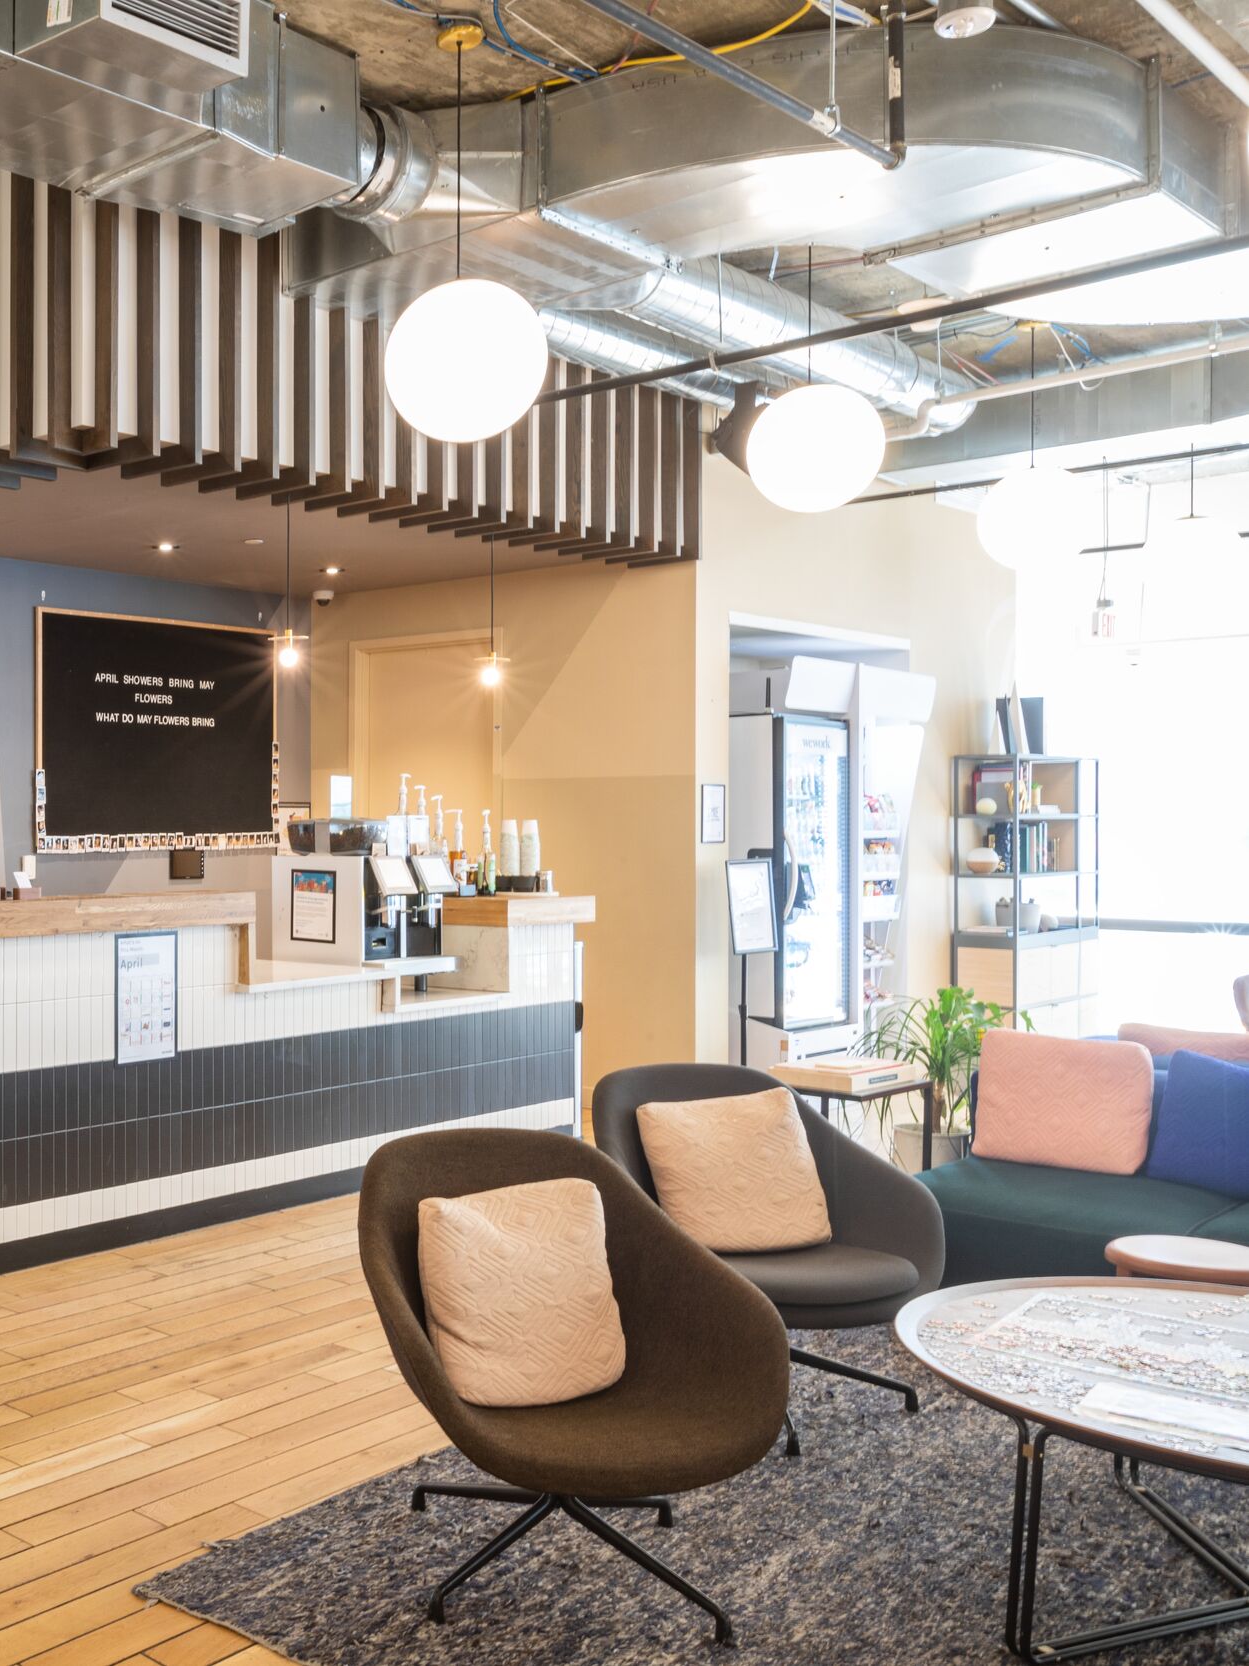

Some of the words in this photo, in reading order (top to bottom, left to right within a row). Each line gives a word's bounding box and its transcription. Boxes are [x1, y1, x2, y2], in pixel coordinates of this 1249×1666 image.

[94, 672, 119, 684] APRIL
[123, 674, 164, 687] SHOWERS
[168, 678, 195, 689] BRING
[199, 680, 215, 690] MAY
[134, 693, 173, 705] FLOWERS
[95, 712, 120, 723] WHAT
[122, 713, 134, 724] DO
[136, 714, 152, 725] MAY
[153, 715, 190, 727] FLOWERS
[191, 717, 215, 728] BRING
[120, 957, 143, 972] April
